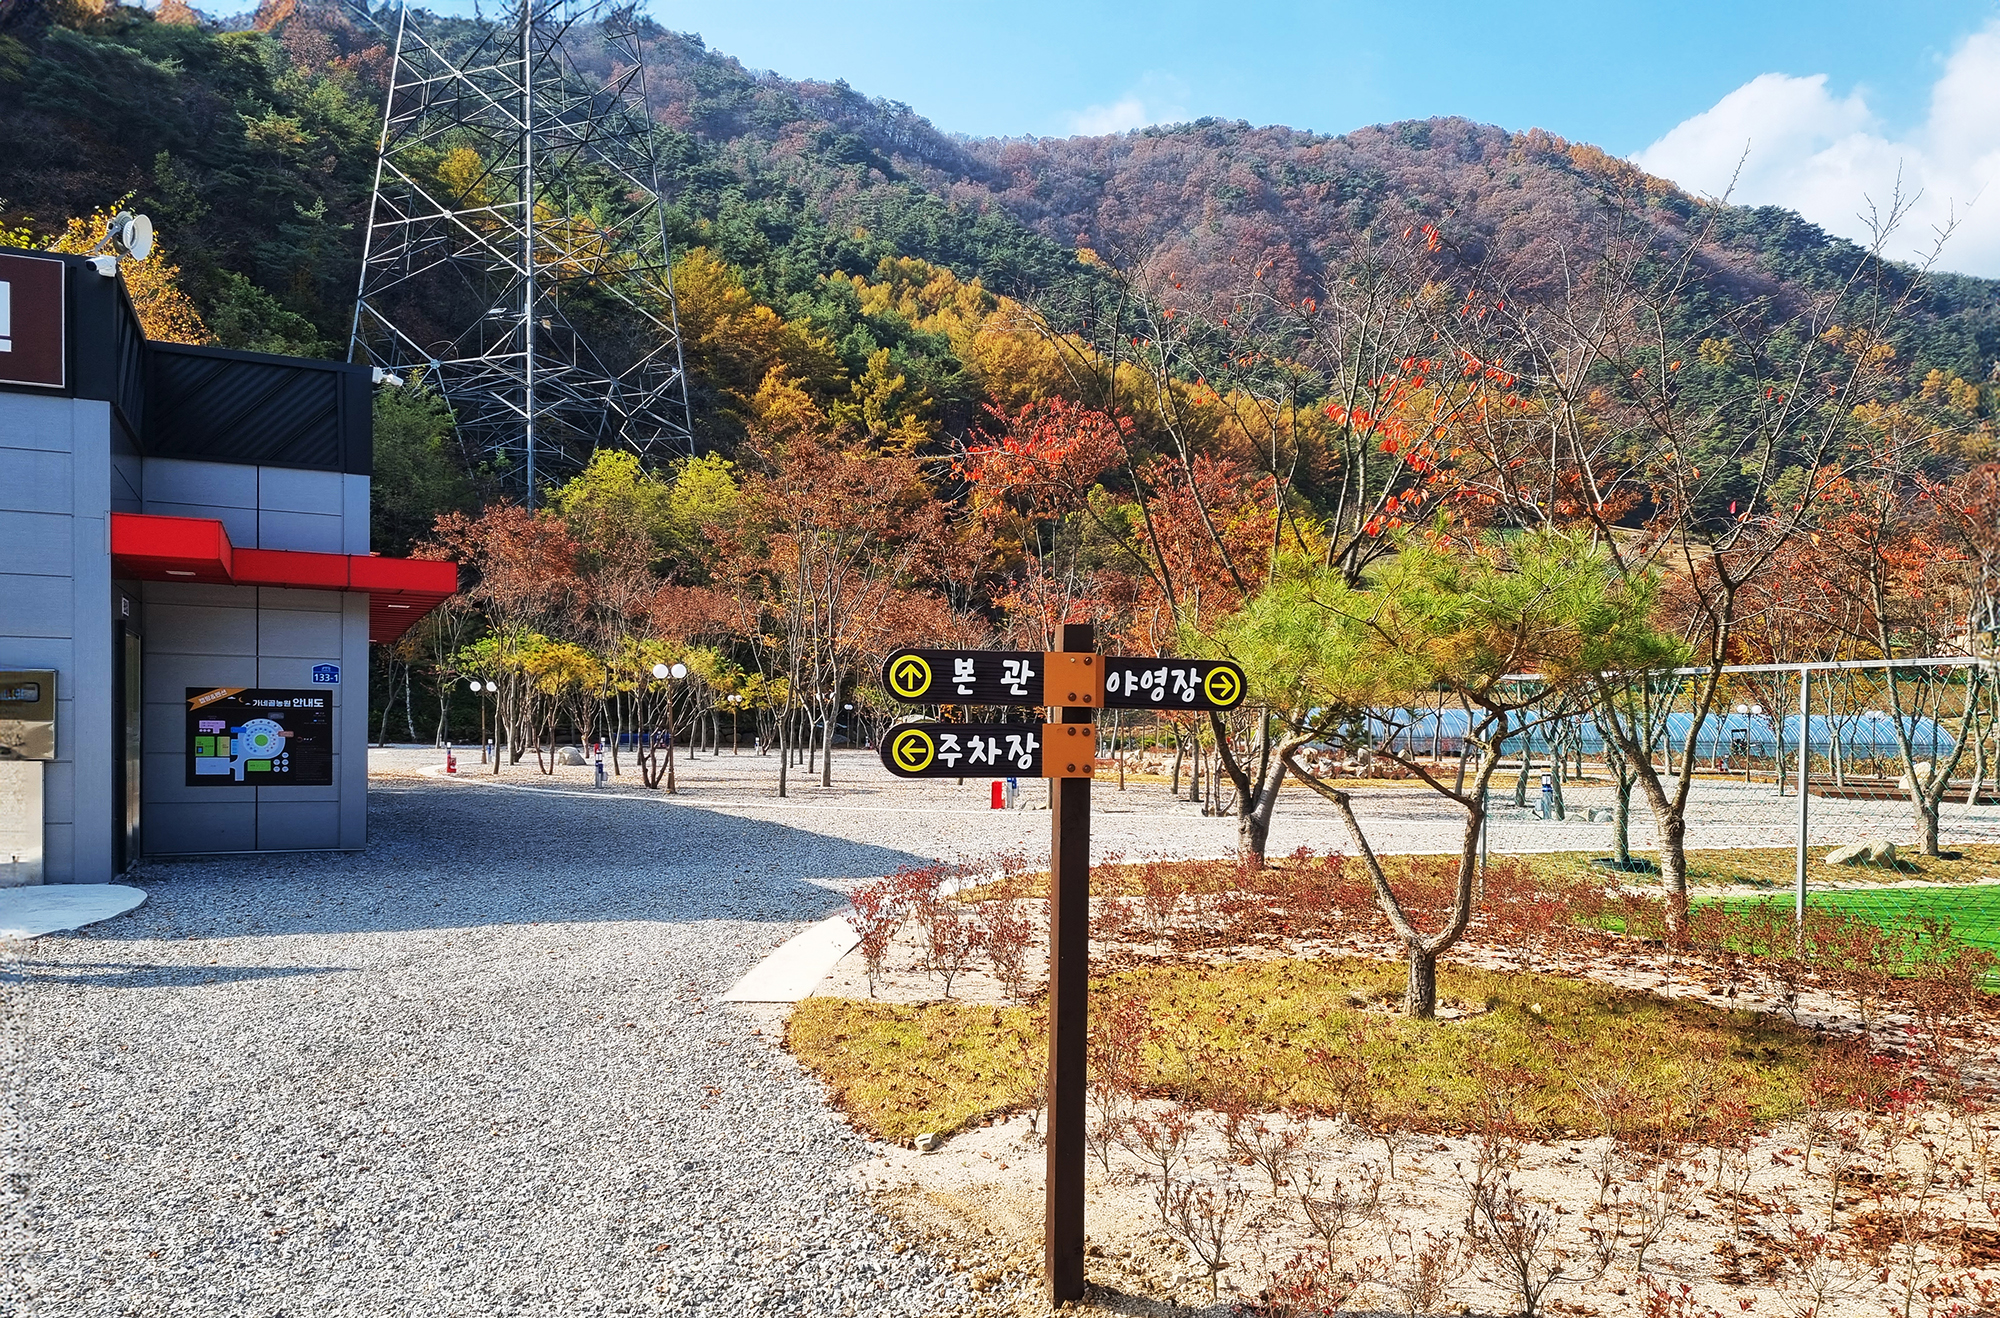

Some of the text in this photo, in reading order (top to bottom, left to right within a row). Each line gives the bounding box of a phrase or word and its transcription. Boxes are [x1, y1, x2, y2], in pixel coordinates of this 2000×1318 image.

[314, 673, 338, 682] 133-1
[952, 657, 1035, 695] 본 관
[1106, 666, 1202, 702] 야영장
[292, 697, 324, 708] 안내도
[937, 732, 1039, 770] 주차장
